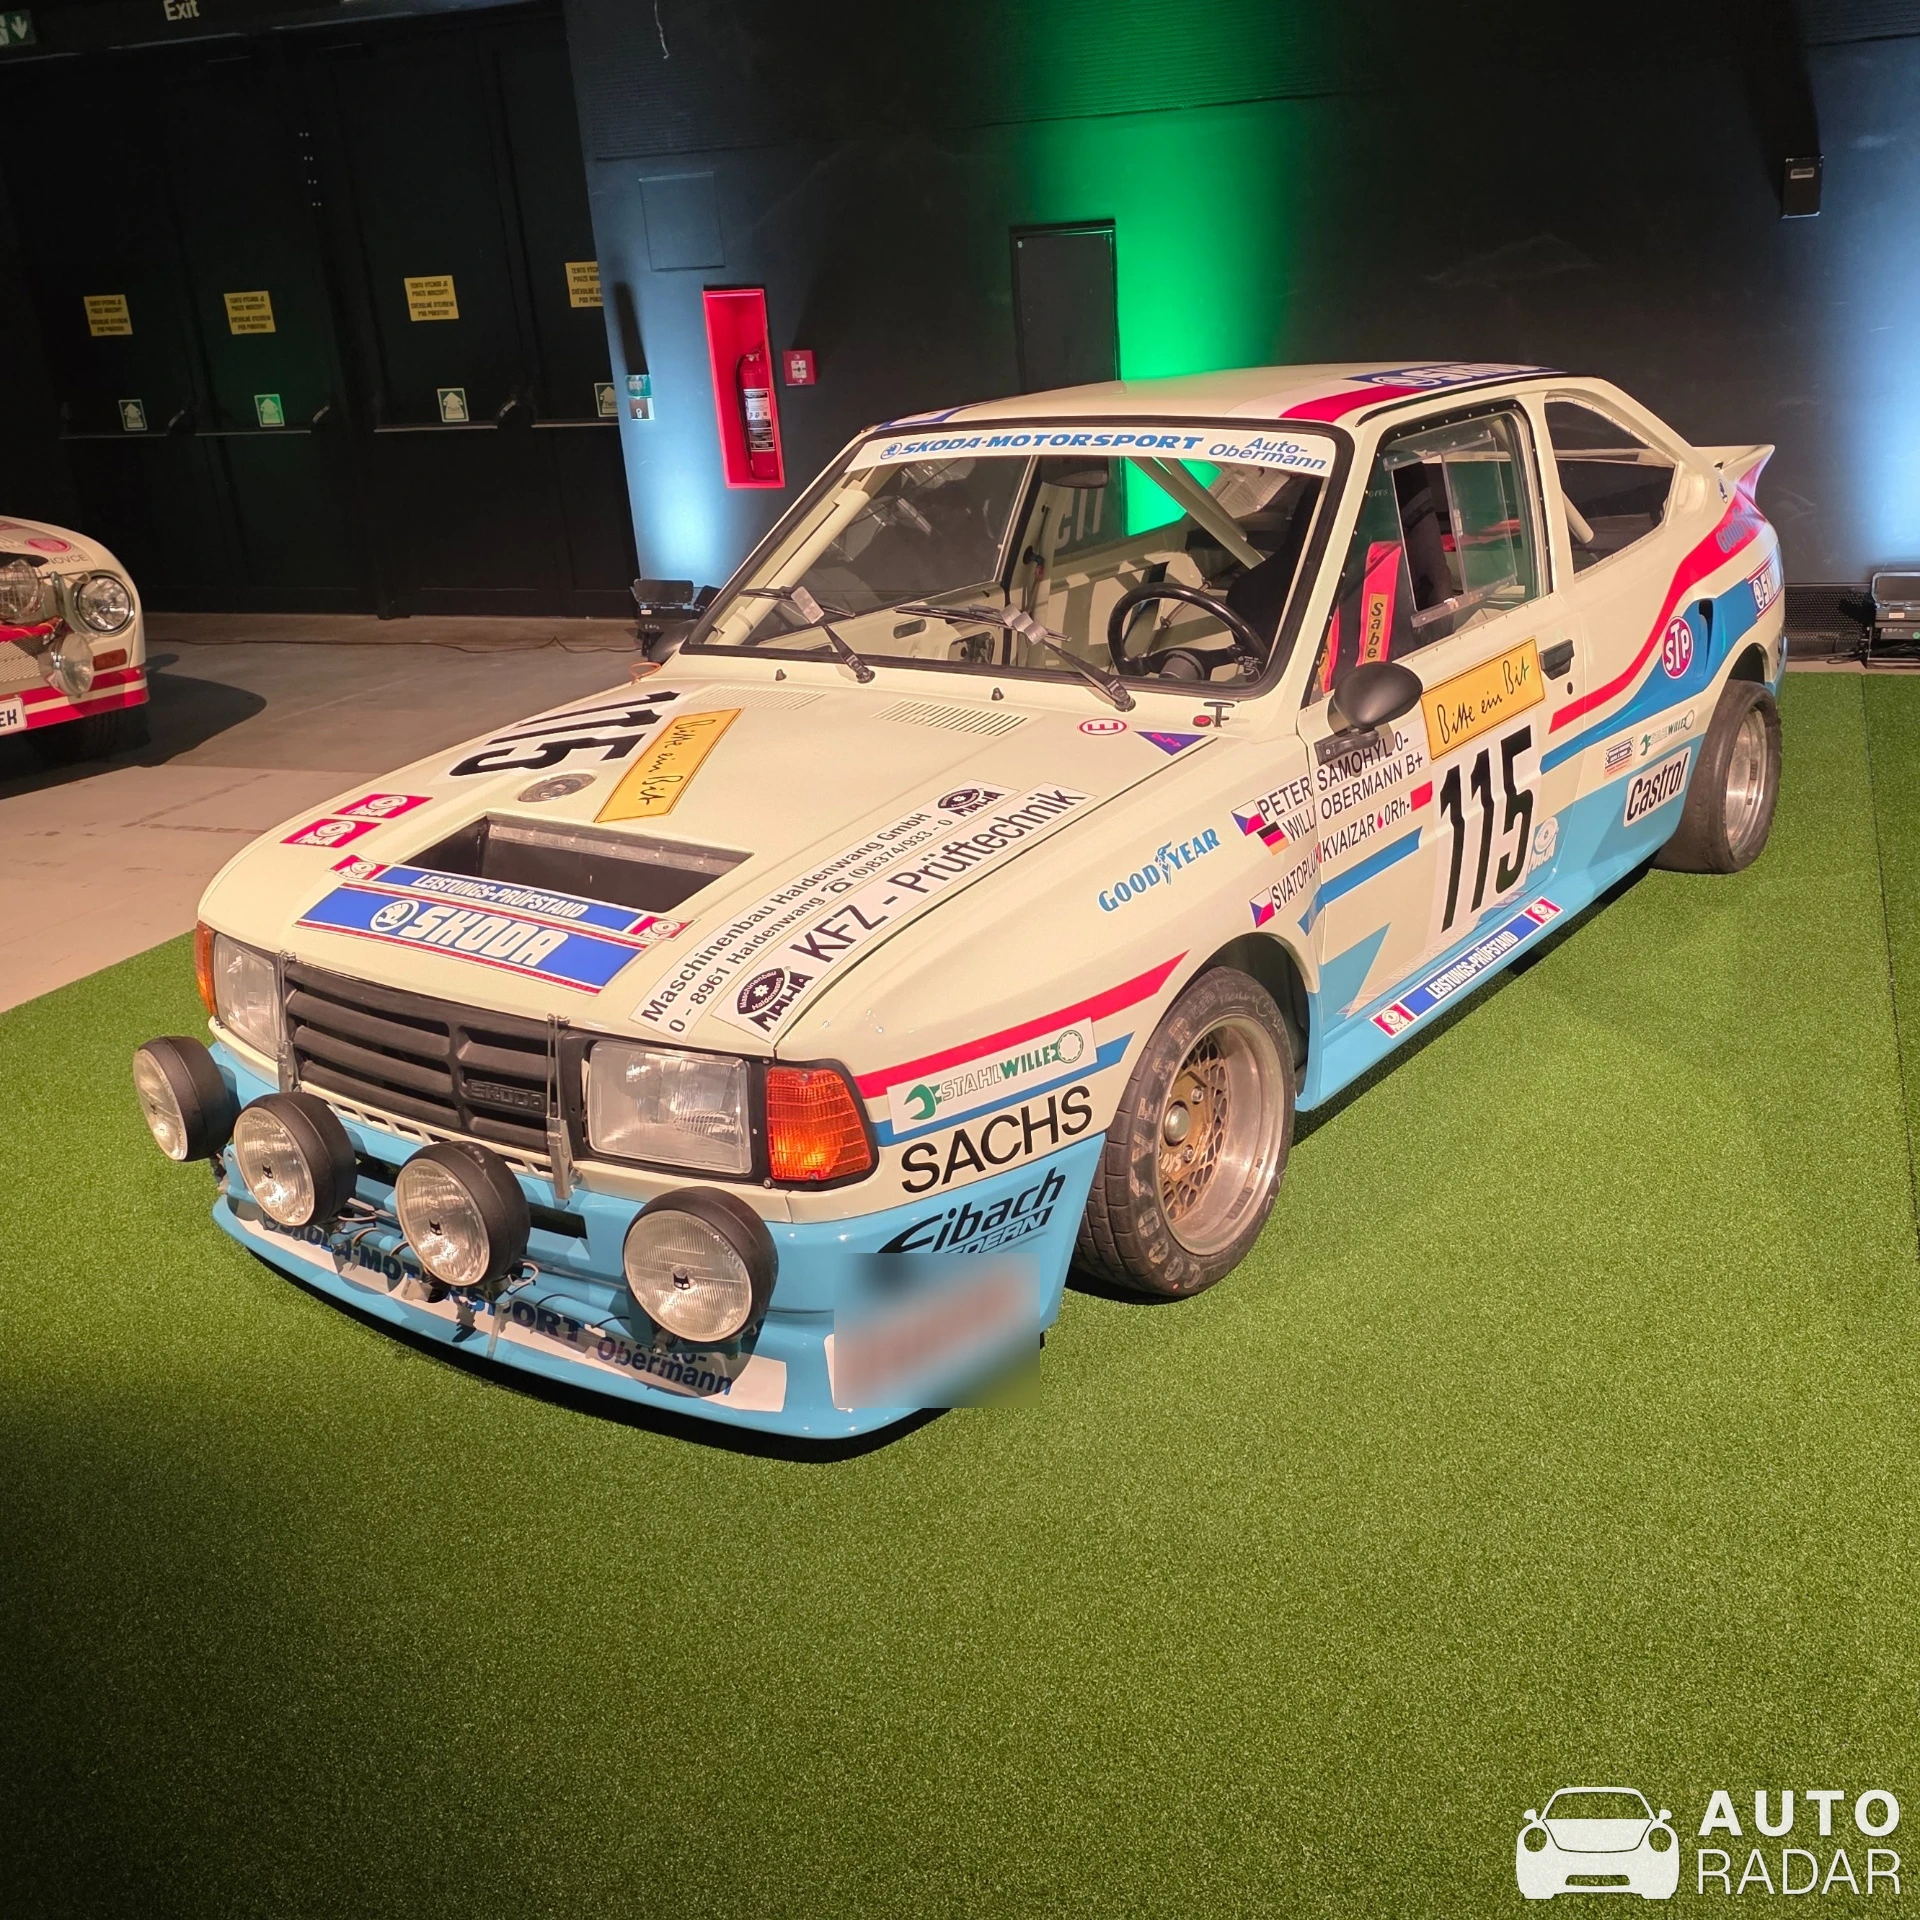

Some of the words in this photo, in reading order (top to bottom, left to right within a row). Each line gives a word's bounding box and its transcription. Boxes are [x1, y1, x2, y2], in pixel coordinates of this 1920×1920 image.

[163, 0, 200, 21] Exit
[899, 433, 1205, 455] SKODA-MOTORSPORT
[1207, 442, 1328, 470] Obermann
[1244, 436, 1309, 456] Auto-
[1665, 620, 1691, 676] STP
[449, 690, 682, 777] 115
[1436, 702, 1476, 744] Bitte
[1481, 693, 1503, 715] ein
[1503, 660, 1530, 695] Bit
[949, 790, 1007, 818] MAHA
[1256, 776, 1314, 822] PETER
[1316, 737, 1394, 792] SAMOHYL
[1320, 759, 1404, 820] OBERMANN
[1406, 751, 1424, 775] B+
[1626, 752, 1689, 822] Castrol
[1321, 813, 1376, 862] KVAIZAR
[1439, 724, 1535, 934] 115
[410, 873, 591, 920] LEISTUNGS-PRÜFSTAND
[788, 902, 889, 964] KFZ
[890, 788, 1089, 894] Prüftechnik
[1098, 827, 1222, 913] GOODYEAR
[407, 903, 570, 969] SKODA
[640, 905, 776, 1023] Maschinenbau
[775, 839, 886, 907] Haldenwang
[877, 812, 932, 849] GmbH
[690, 966, 731, 1006] 8961
[725, 894, 826, 966] Haldenwang
[848, 828, 933, 880] (0)8374/933
[1424, 929, 1520, 1000] LEISTUNGS-PRÜFSTAND
[747, 970, 815, 1034] MAHA
[470, 1081, 545, 1110] SKODA
[940, 1044, 1058, 1102] STAHLWILLE
[901, 1084, 1093, 1194] SACHS
[876, 1166, 1067, 1254] Eibach
[596, 1336, 735, 1396] Obermann
